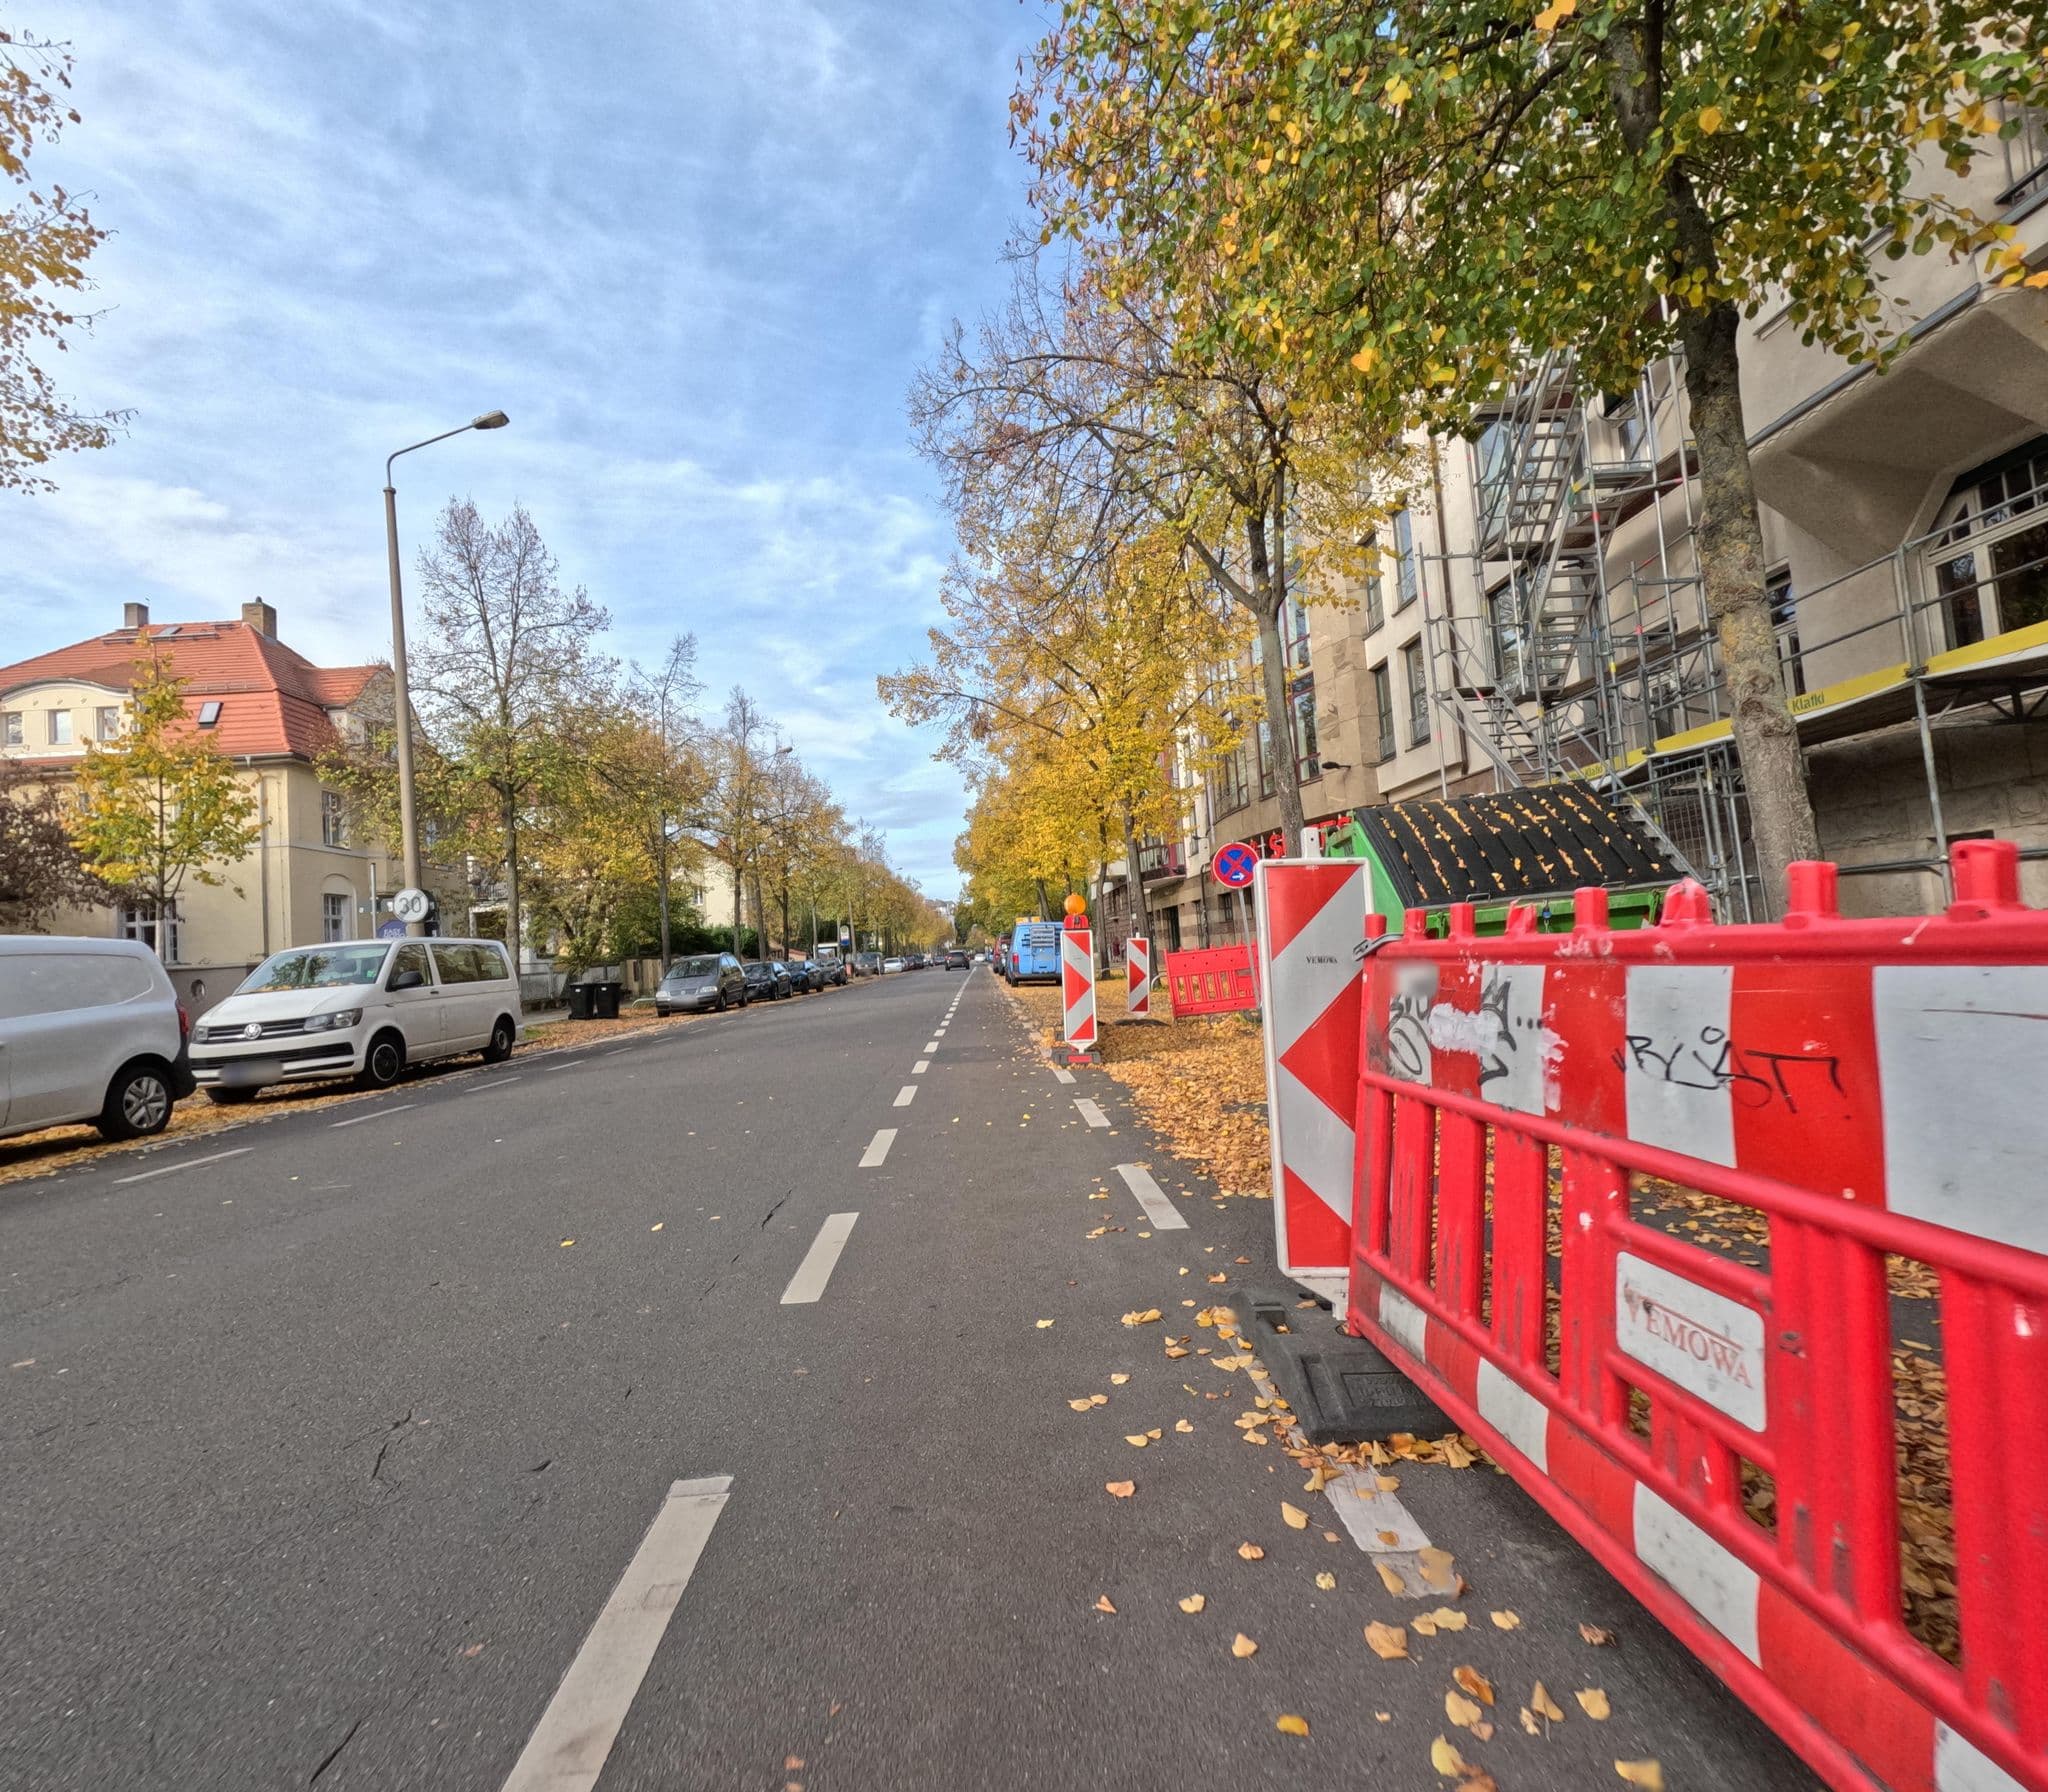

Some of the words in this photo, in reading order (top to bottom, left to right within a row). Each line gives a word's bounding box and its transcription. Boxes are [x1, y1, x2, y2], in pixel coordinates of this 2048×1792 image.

[399, 896, 421, 914] 30
[1306, 956, 1337, 964] VEMOWA
[1624, 1285, 1753, 1389] VEMOWA
